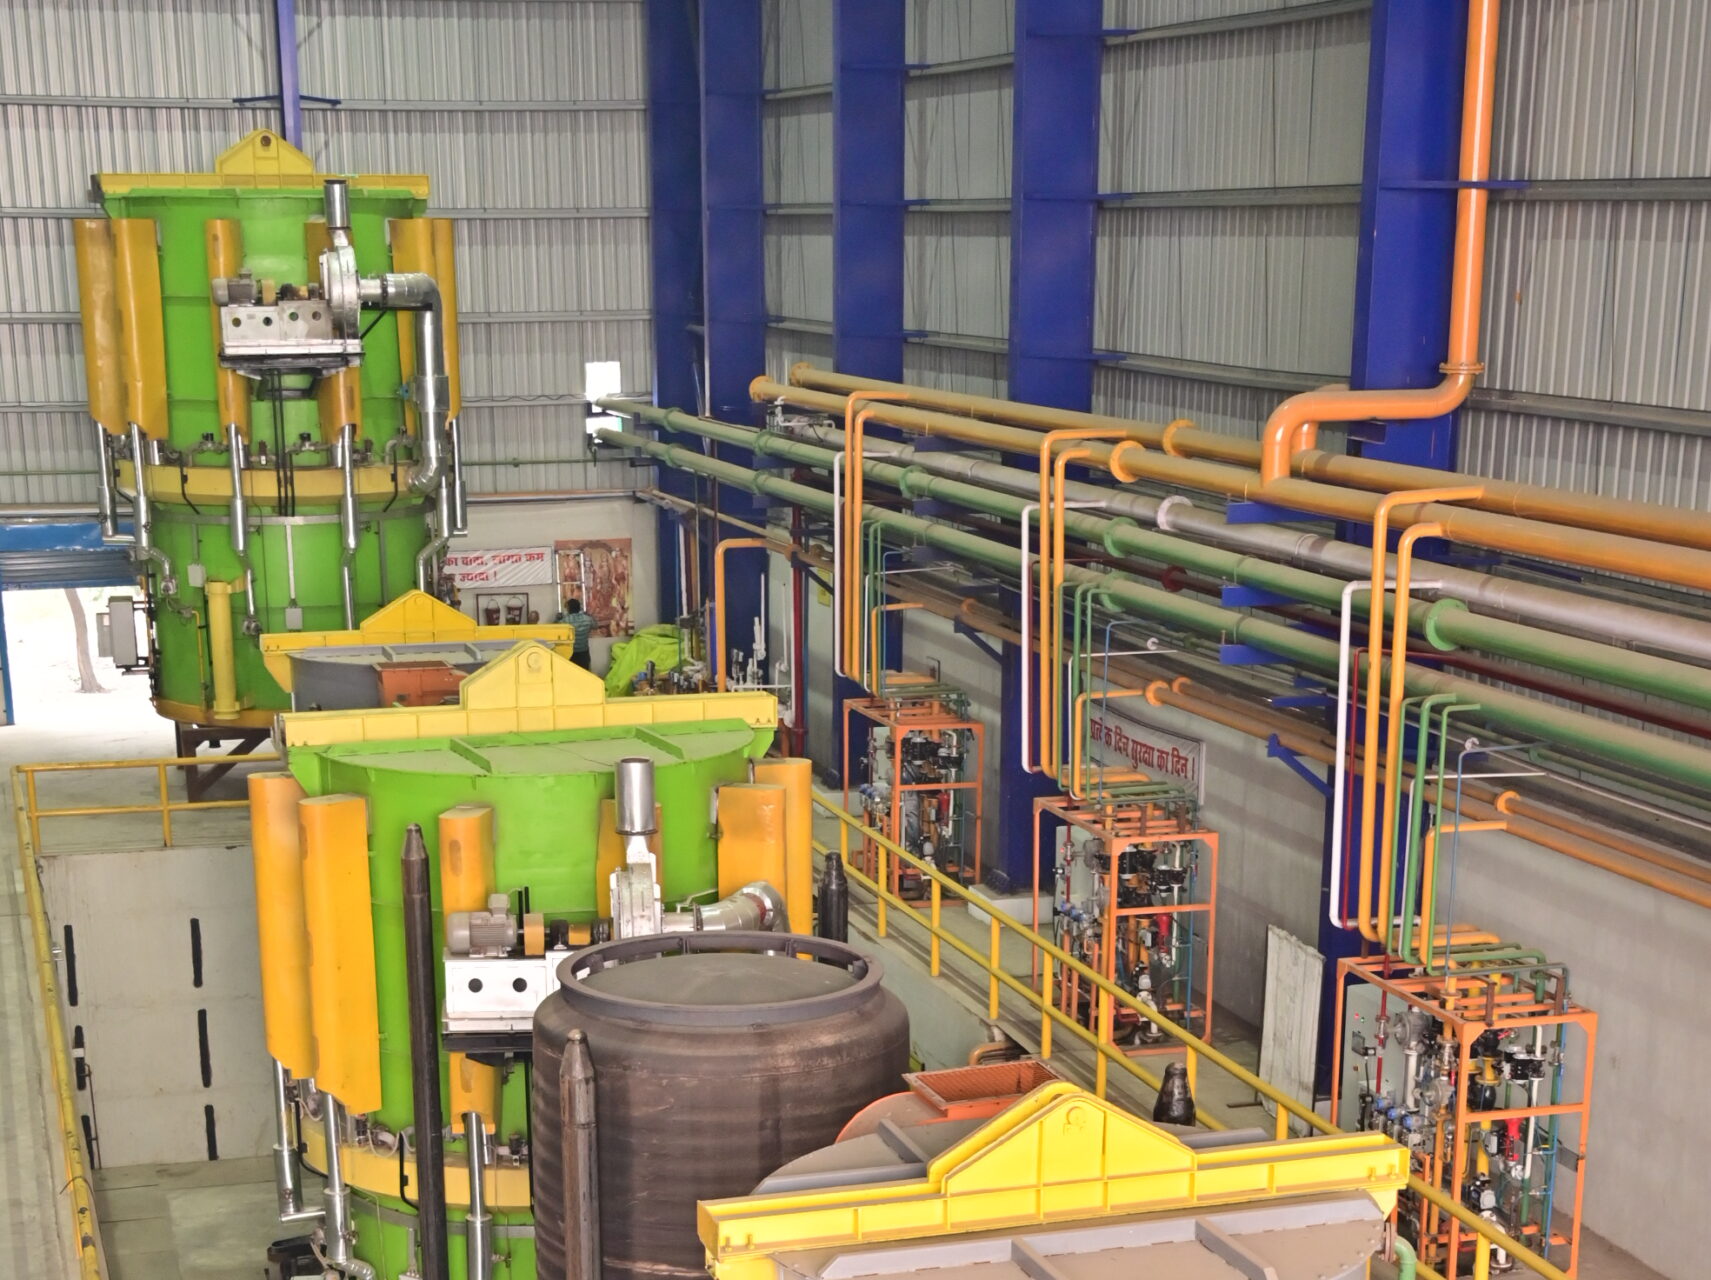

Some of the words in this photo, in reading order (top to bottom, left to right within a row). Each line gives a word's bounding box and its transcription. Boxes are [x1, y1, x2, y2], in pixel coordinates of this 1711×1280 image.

[1114, 725, 1130, 757] दिन
[1131, 739, 1156, 769] सुरक्षा
[1157, 748, 1169, 773] का
[1171, 746, 1189, 779] दिन
